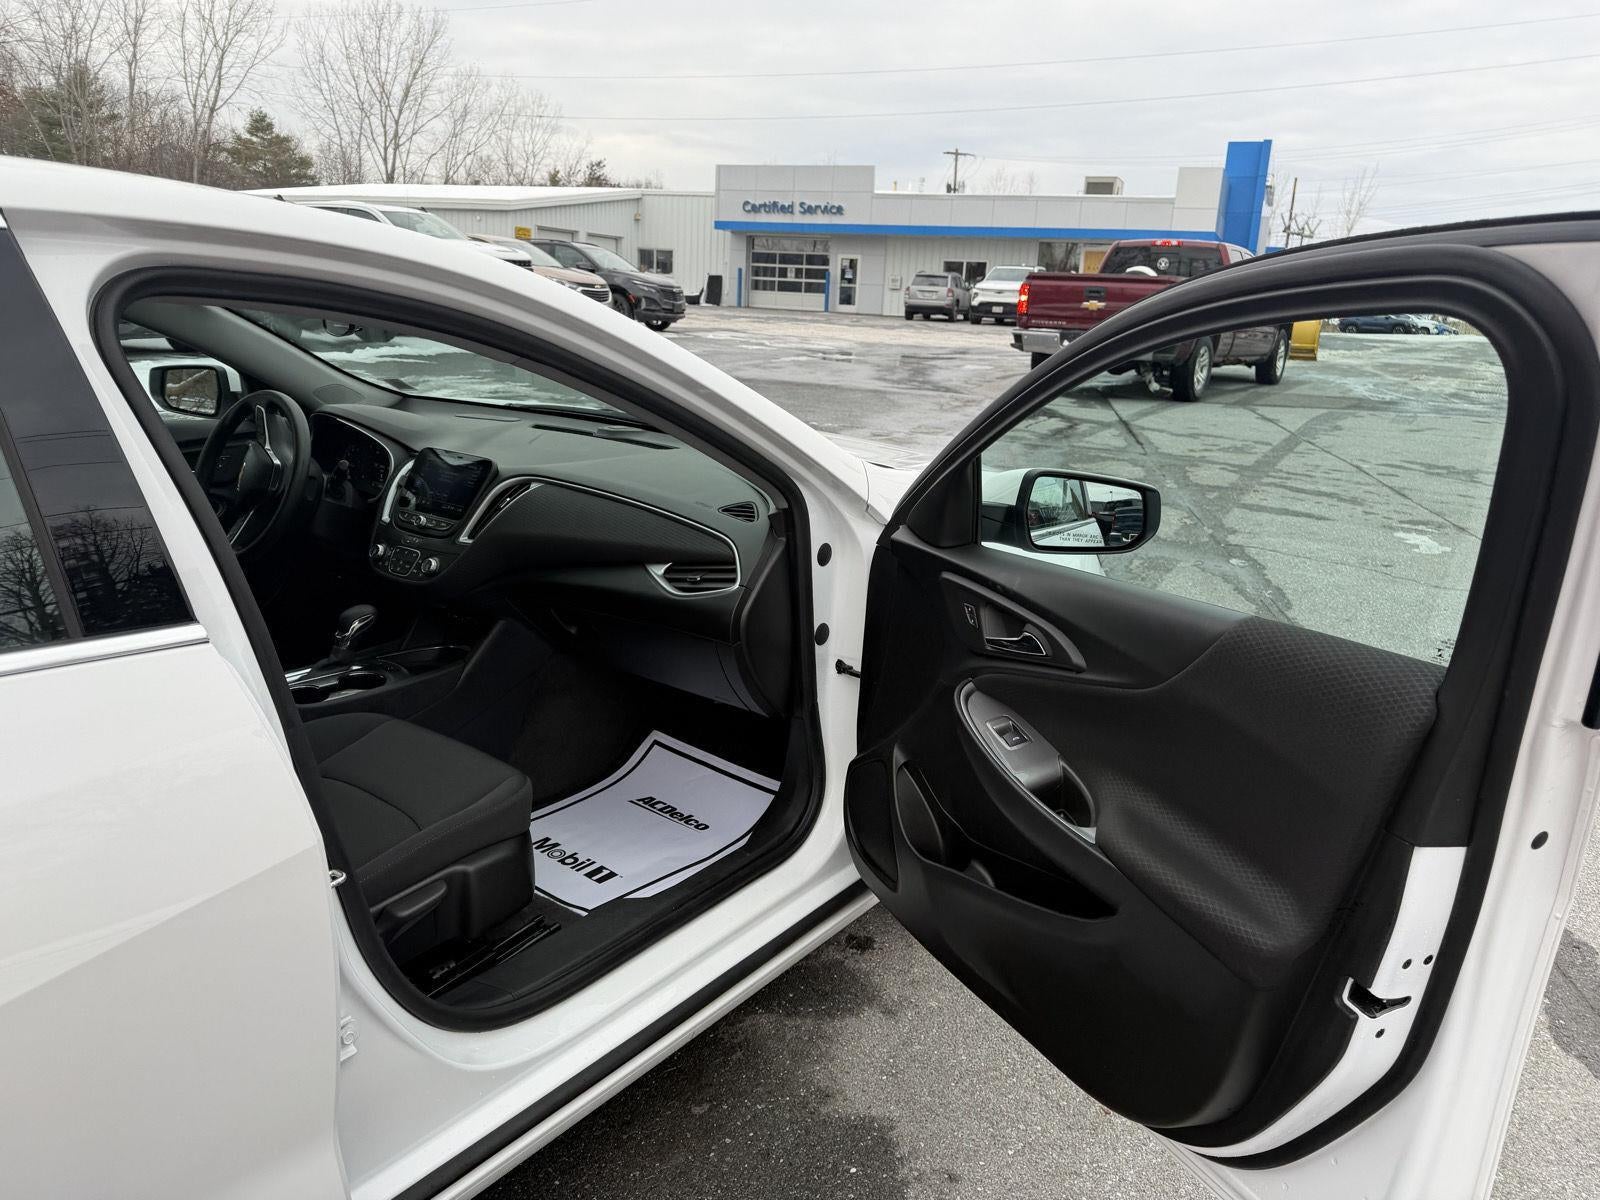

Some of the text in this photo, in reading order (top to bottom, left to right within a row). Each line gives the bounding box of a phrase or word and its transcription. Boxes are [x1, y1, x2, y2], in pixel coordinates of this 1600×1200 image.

[742, 200, 845, 216] Certified Service
[634, 796, 710, 831] ACDelco
[532, 837, 597, 873] Mobil
